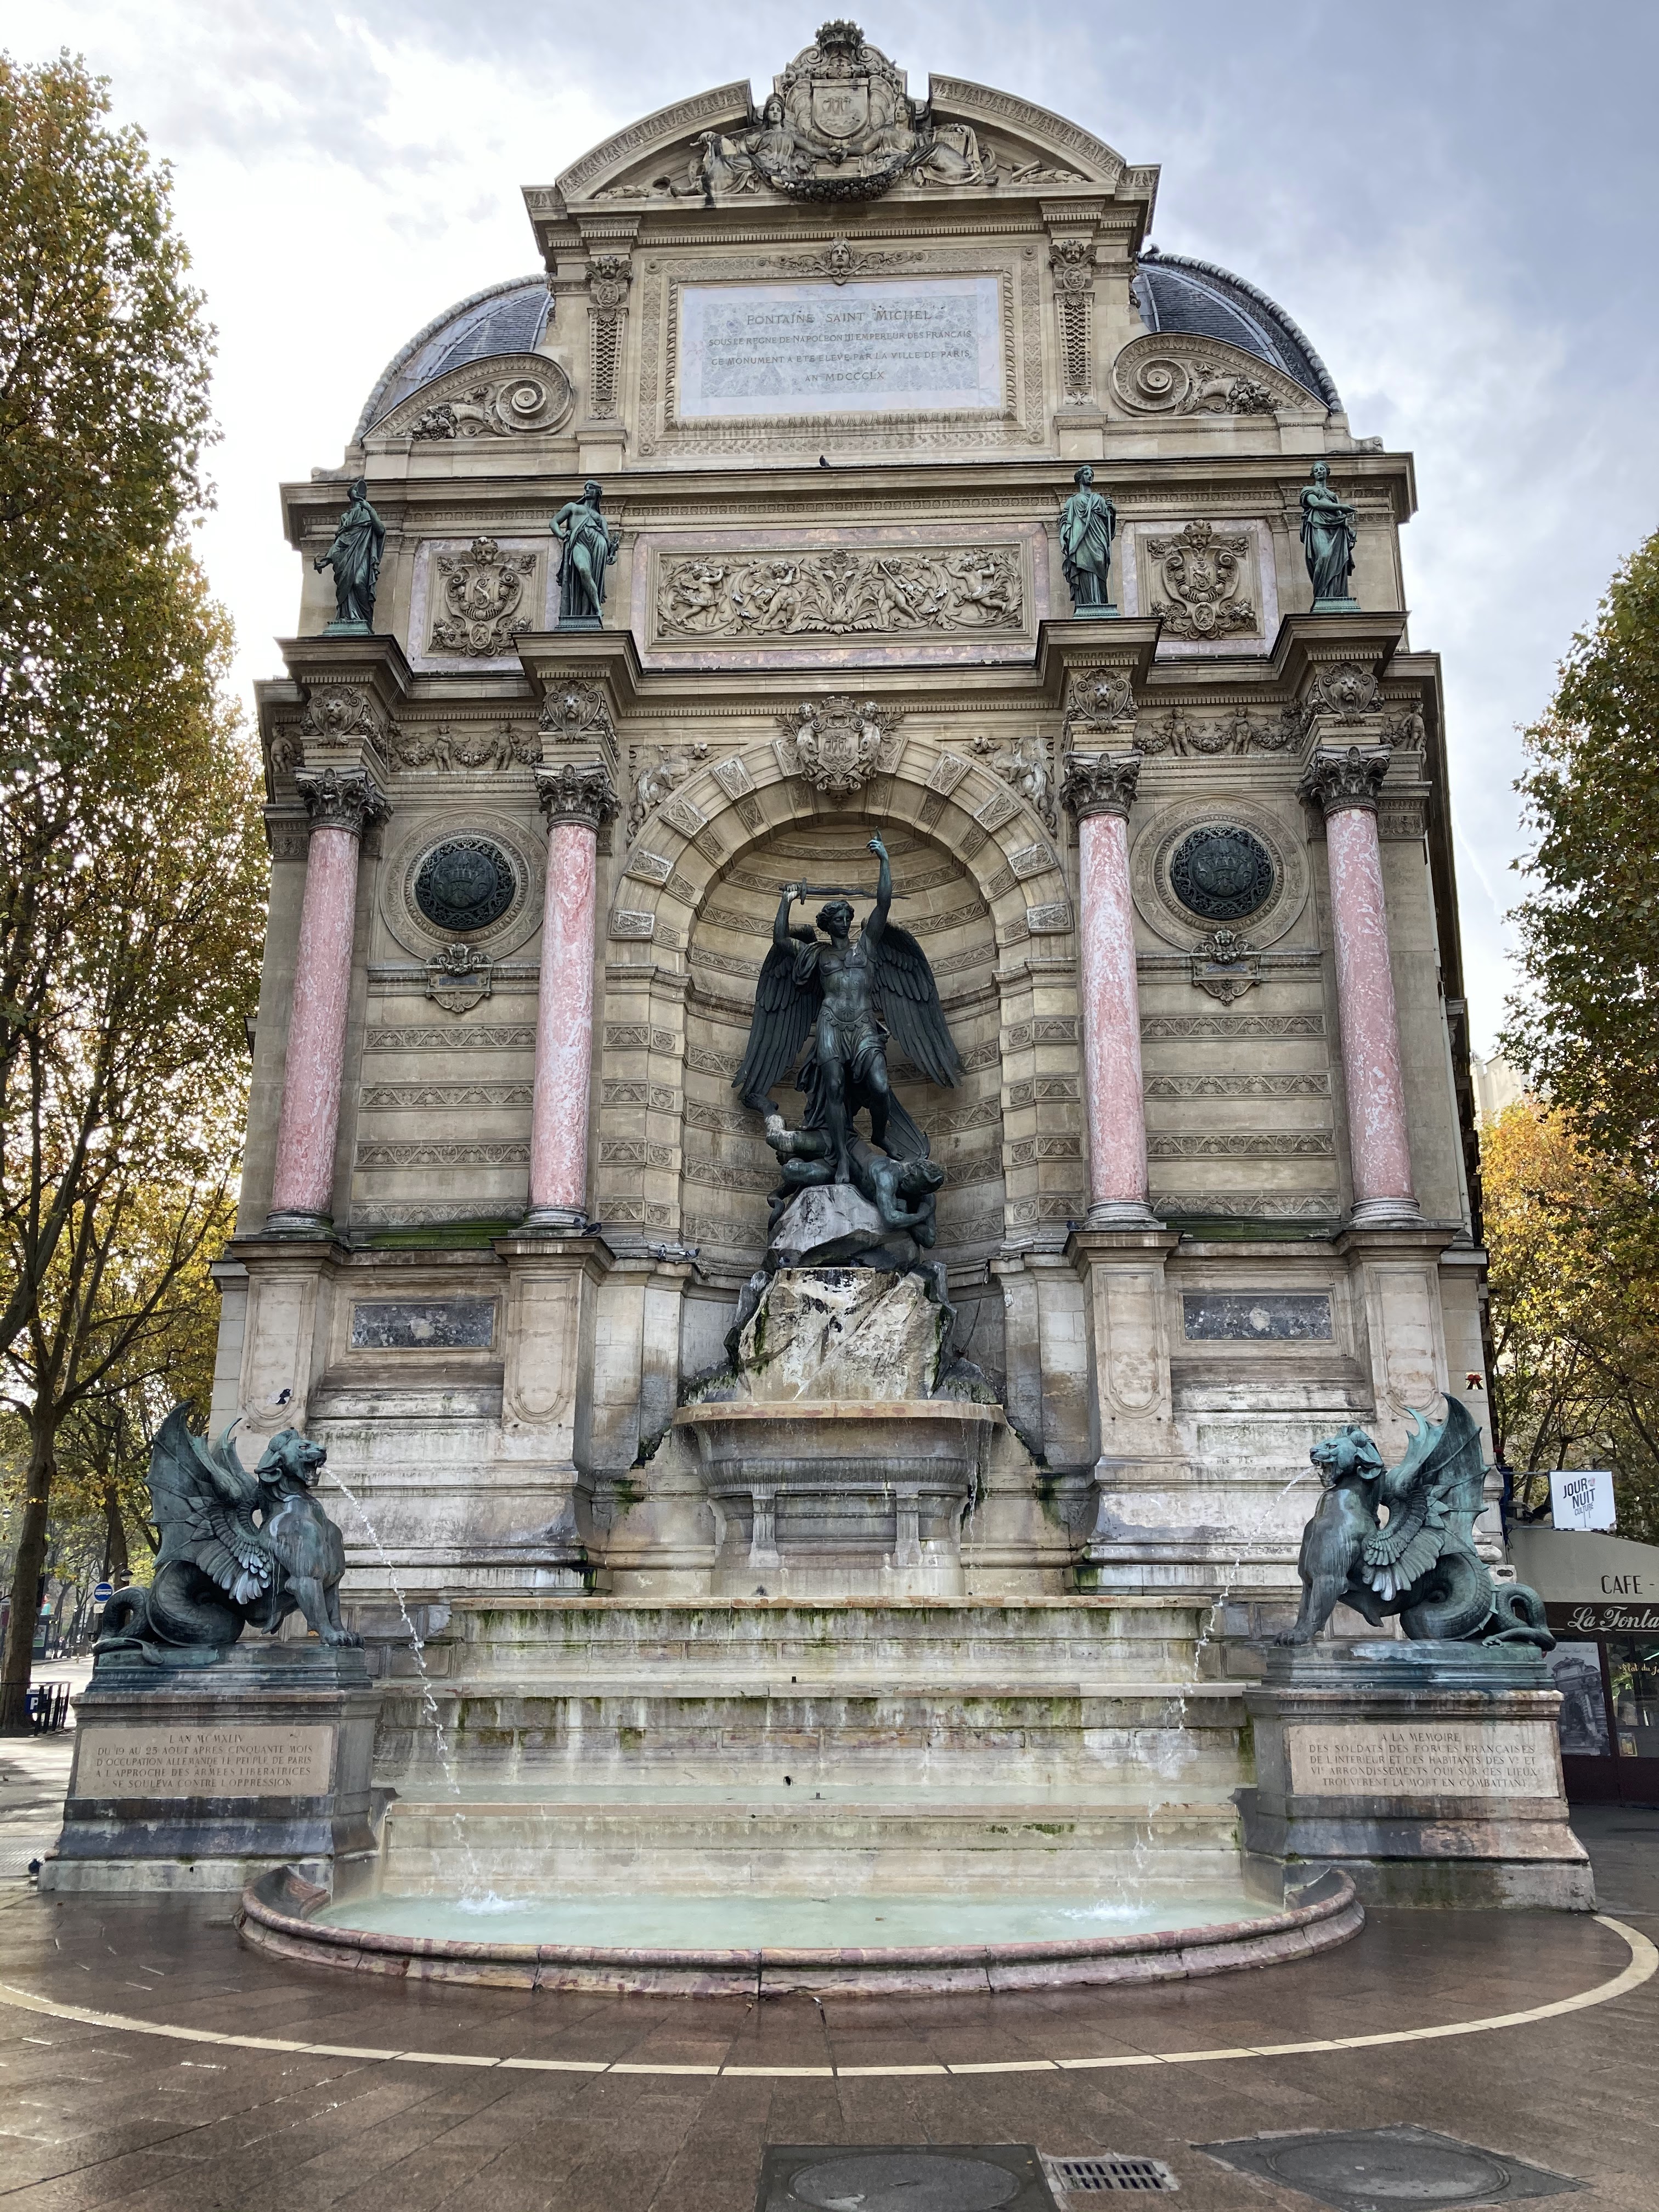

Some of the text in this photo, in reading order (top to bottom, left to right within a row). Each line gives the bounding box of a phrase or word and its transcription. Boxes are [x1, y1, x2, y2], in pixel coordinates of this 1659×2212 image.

[747, 311, 932, 325] FONTAINE SAINT MICHEL
[793, 335, 843, 343] NAPOLEON
[727, 356, 785, 366] MONUMENT
[825, 371, 884, 381] MDCCCLX
[1563, 1477, 1588, 1499] JOUR
[1572, 1488, 1595, 1509] NUIT
[1574, 1502, 1594, 1516] CULTURE
[1601, 1575, 1643, 1594] CAFE
[1567, 1607, 1597, 1632] La
[1641, 1663, 1650, 1671] du
[30, 1697, 39, 1710] P
[1392, 1733, 1404, 1742] LA
[1409, 1733, 1462, 1742] MEMOIRE
[98, 1747, 110, 1756] DU
[129, 1746, 142, 1755] AU
[146, 1746, 158, 1755] 25
[162, 1746, 189, 1755] AOUT
[228, 1745, 284, 1754] CINQUANTE
[290, 1745, 313, 1753] MOIS
[1309, 1745, 1328, 1753] DES
[1335, 1745, 1383, 1753] SOLDATS
[1389, 1745, 1408, 1753] DES
[1414, 1745, 1458, 1753] FORCES
[166, 1757, 218, 1766] ALLEMANDE
[236, 1756, 268, 1765] PEUPLE
[272, 1756, 284, 1764] DE
[287, 1756, 312, 1764] PARIS
[1310, 1756, 1323, 1764] DE
[1390, 1756, 1400, 1764] ET
[1406, 1756, 1424, 1764] DES
[1429, 1756, 1481, 1764] HABITANTS
[1486, 1756, 1505, 1764] DES
[1524, 1756, 1536, 1765] ET
[171, 1768, 190, 1776] DES
[240, 1767, 311, 1776] LIBERATRICES
[1330, 1767, 1428, 1775] ARRONDISSEMENTS
[1434, 1767, 1453, 1776] QUI
[1458, 1767, 1479, 1775] SUR
[1482, 1767, 1502, 1775] CES
[1507, 1767, 1538, 1776] LIEUX
[113, 1780, 124, 1788] SE
[177, 1779, 217, 1787] CONTRE
[1323, 1778, 1528, 1787] TROUVERENT LA MORT EN COMBATTANT
